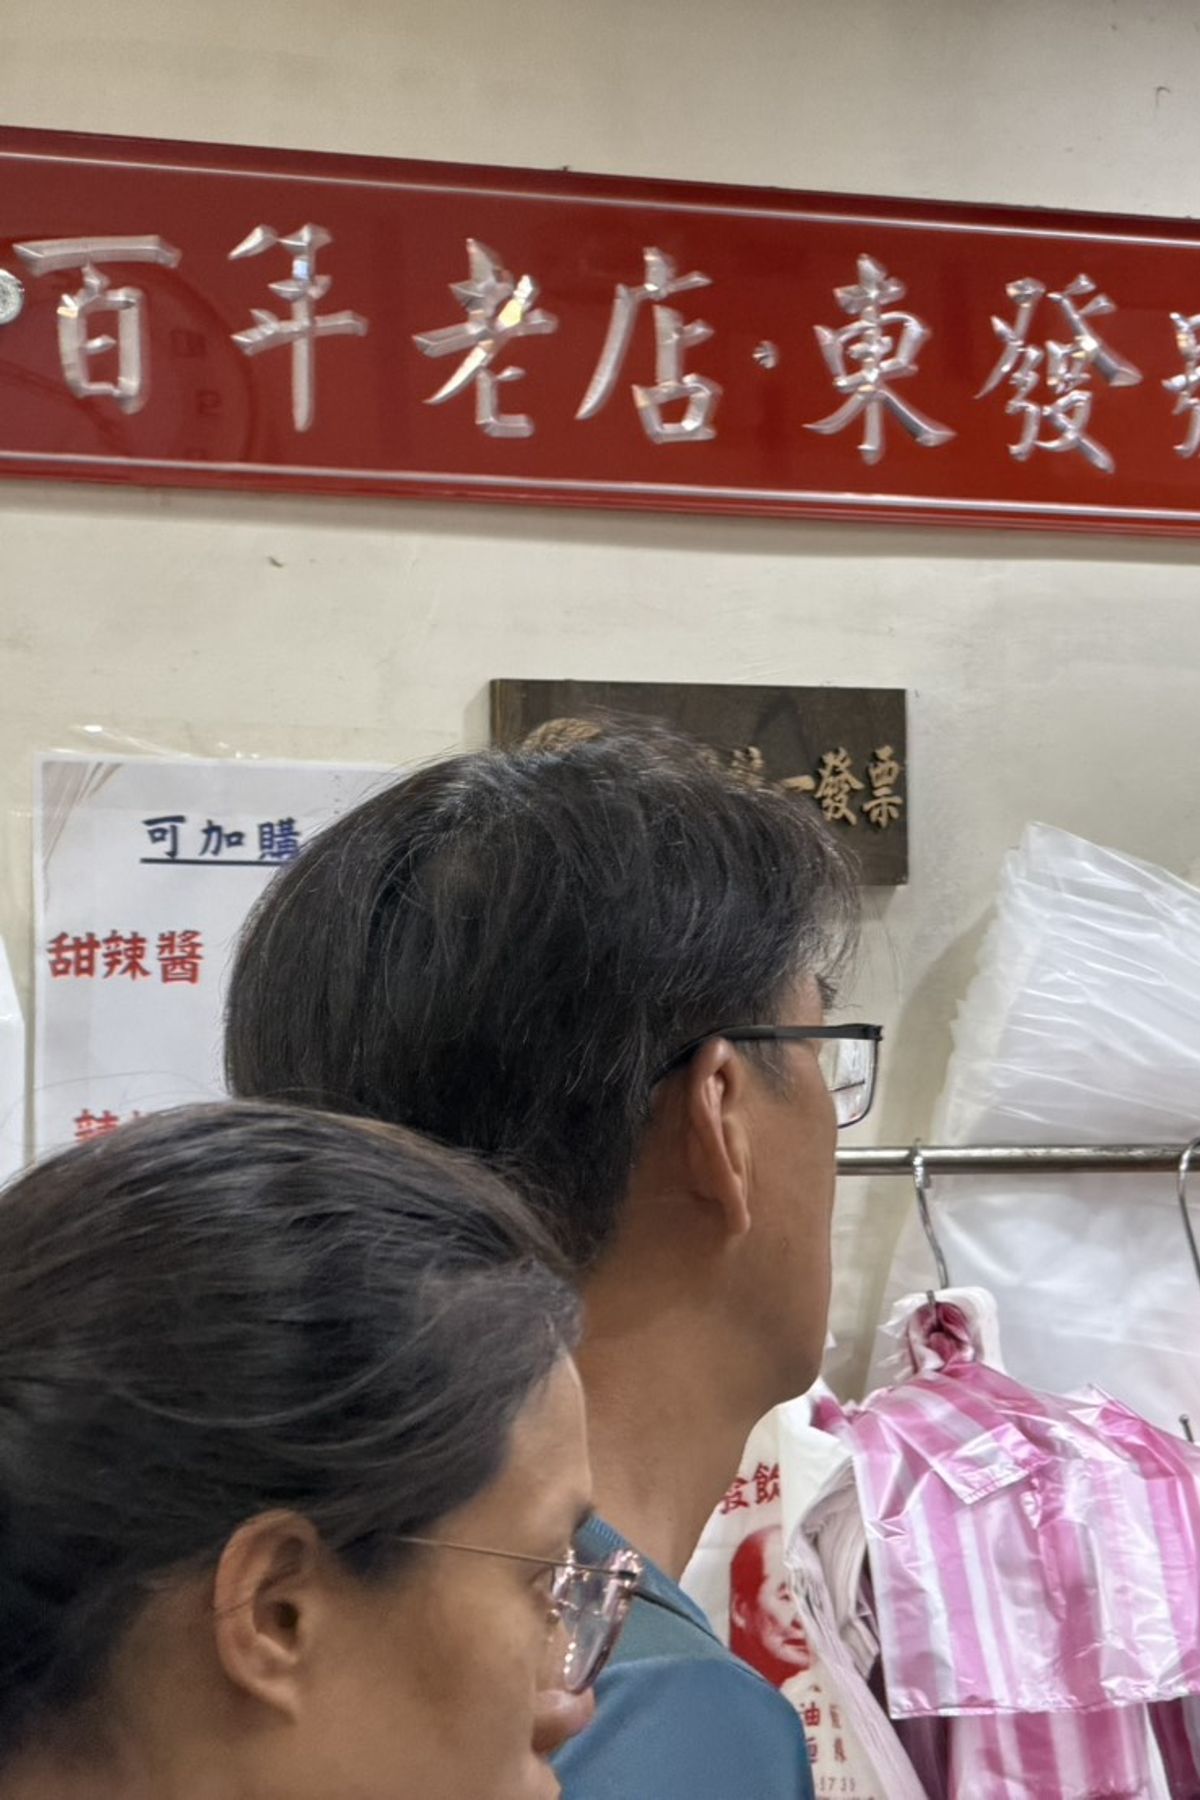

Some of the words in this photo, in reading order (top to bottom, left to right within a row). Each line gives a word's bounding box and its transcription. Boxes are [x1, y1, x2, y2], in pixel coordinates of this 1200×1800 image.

[141, 815, 301, 861] 可加購
[46, 929, 204, 984] 甜辣醬
